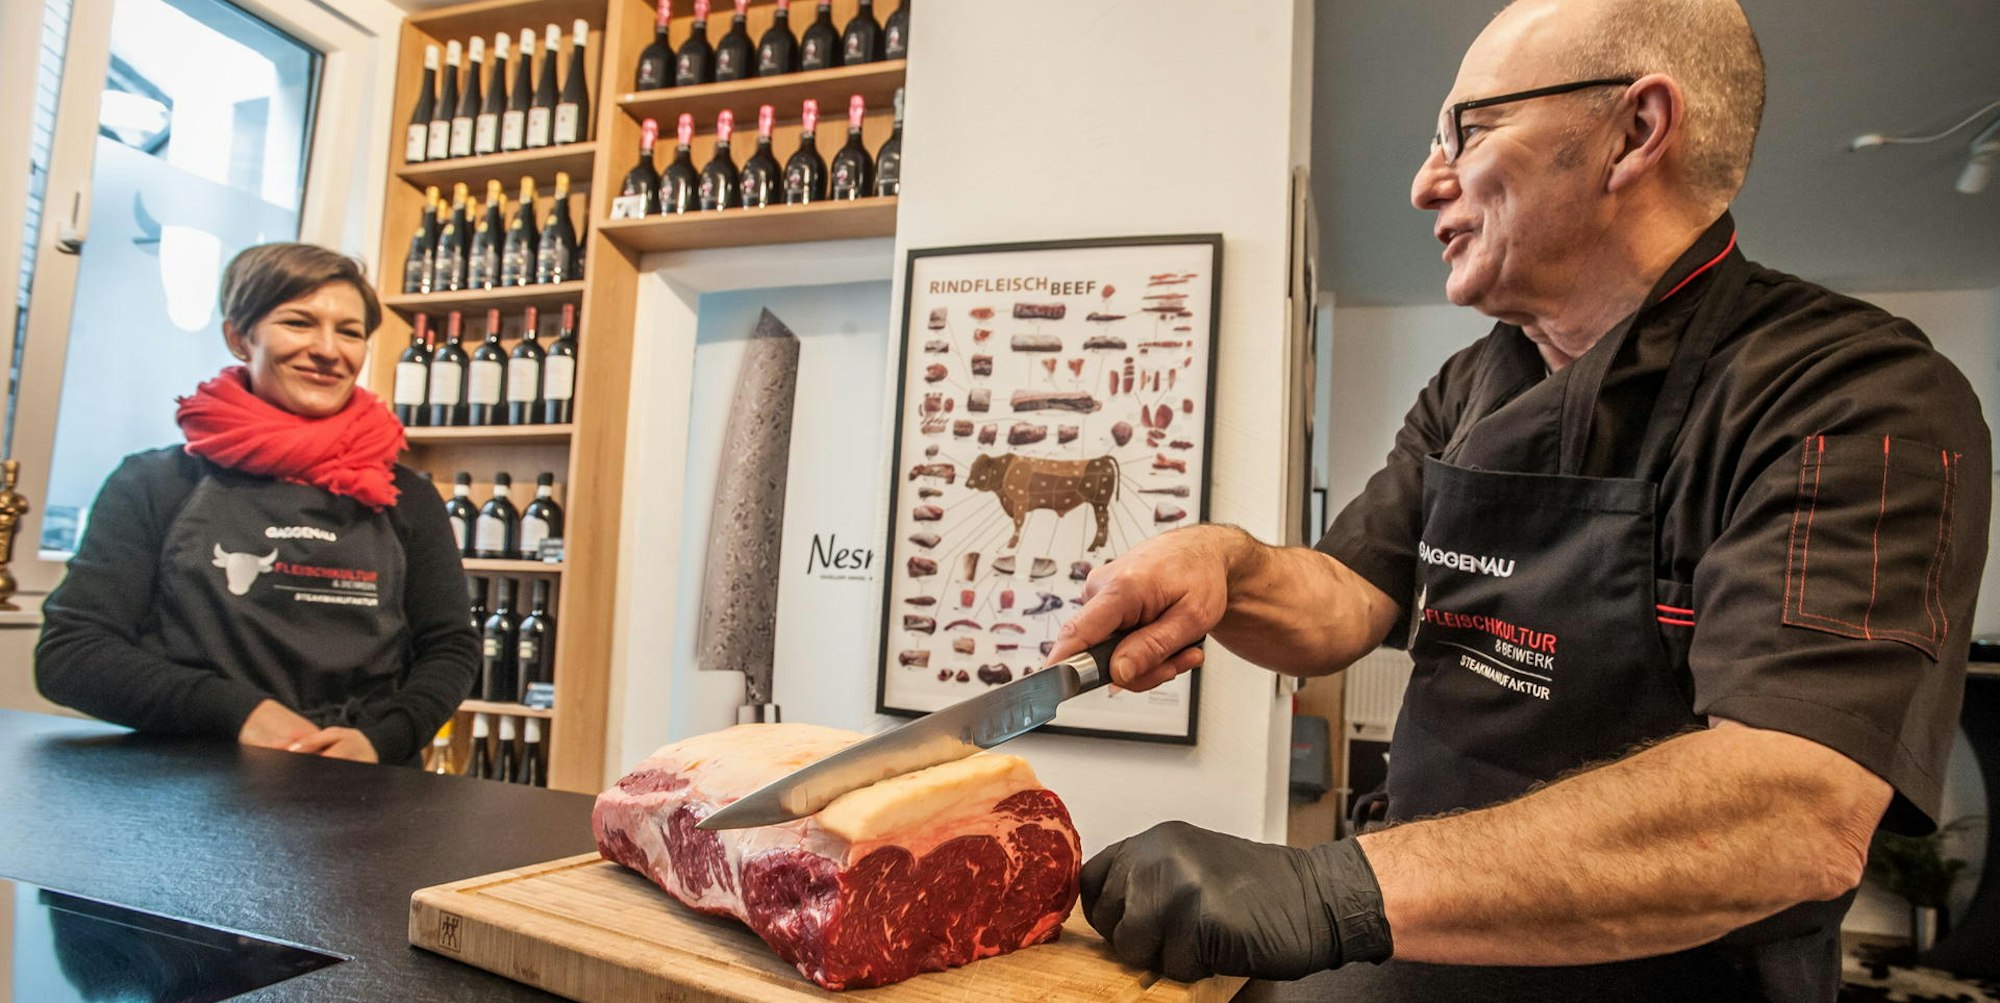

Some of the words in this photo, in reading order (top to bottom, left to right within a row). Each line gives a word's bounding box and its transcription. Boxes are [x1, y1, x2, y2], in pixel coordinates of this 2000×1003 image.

[929, 276, 1048, 294] RINDFLEISCH
[1050, 280, 1097, 296] BEEF
[1418, 540, 1515, 577] GAGGENAU
[1425, 608, 1558, 654] FLEISCHKULTUR
[1502, 641, 1554, 670] BEIWERK
[1460, 654, 1550, 700] STEAKMANUFAKTUR
